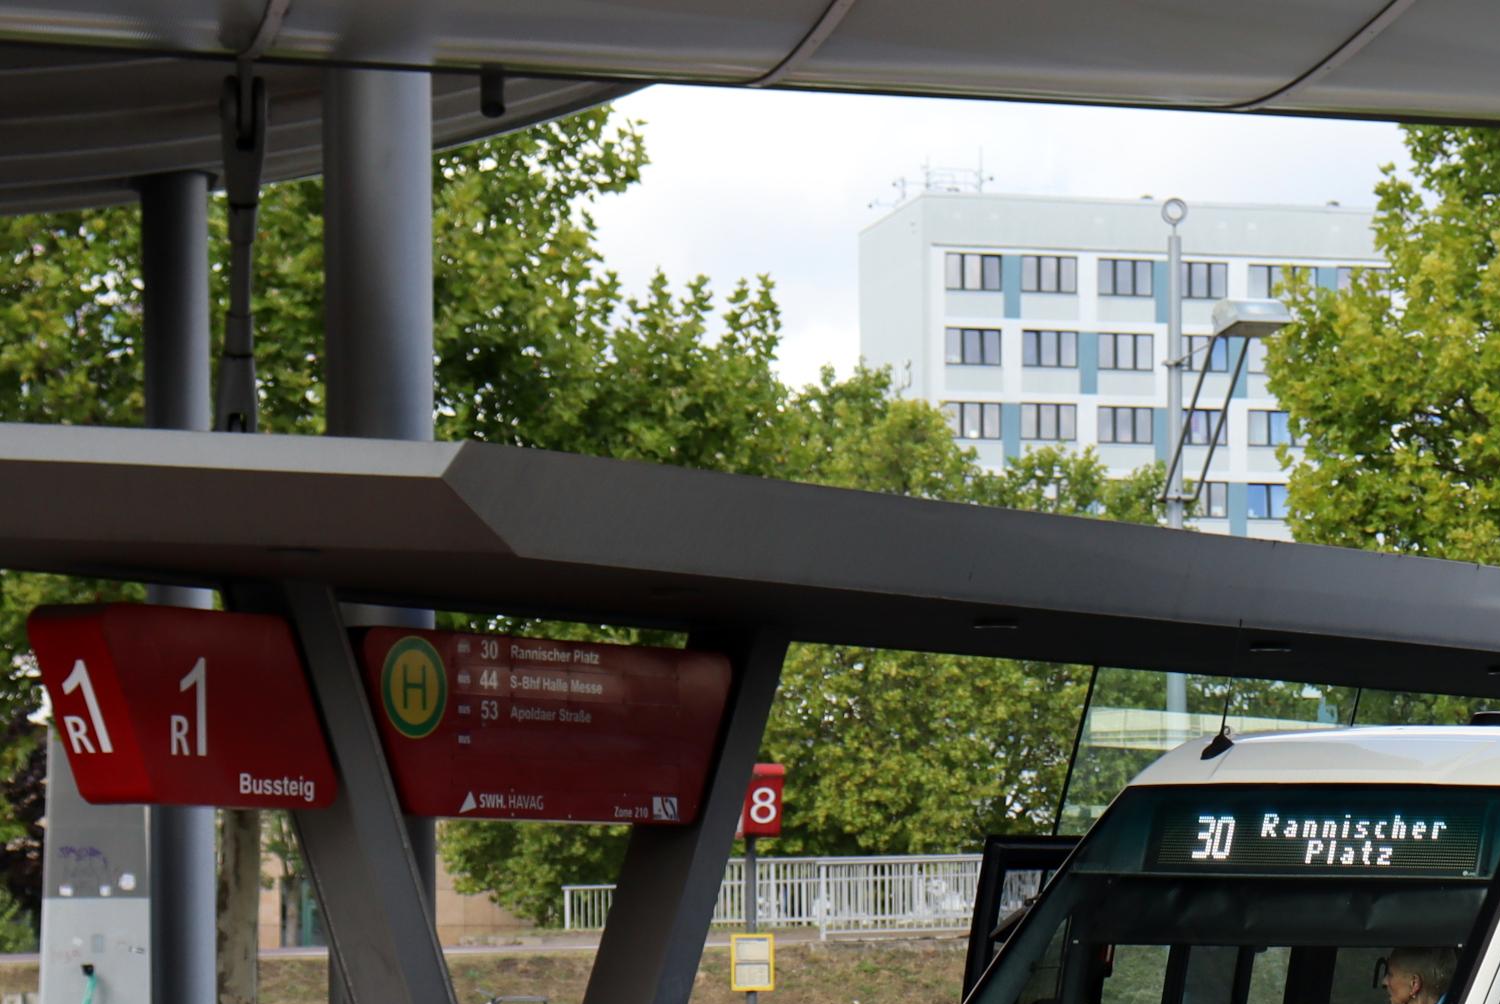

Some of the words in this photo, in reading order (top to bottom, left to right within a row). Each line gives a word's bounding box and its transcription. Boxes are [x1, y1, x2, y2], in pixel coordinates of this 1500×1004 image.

[480, 639, 499, 660] 30
[510, 645, 571, 663] Rannischer
[573, 650, 600, 665] Platz
[402, 663, 427, 711] H
[479, 669, 499, 690] 44
[509, 675, 541, 690] S-Bhf
[541, 677, 568, 692] Halle
[570, 680, 604, 695] Messe
[61, 659, 114, 754] R1
[171, 656, 207, 757] R1
[480, 700, 499, 720] 53
[510, 705, 556, 722] Apoldaer
[559, 708, 592, 723] Straße
[239, 772, 315, 801] Bussteig
[508, 795, 544, 810] HAVAG
[614, 805, 633, 817] Zone
[635, 807, 649, 818] 210
[750, 786, 777, 824] 8
[1191, 816, 1236, 859] 30
[1261, 813, 1447, 839] Rannischer
[1304, 840, 1393, 865] Platz
